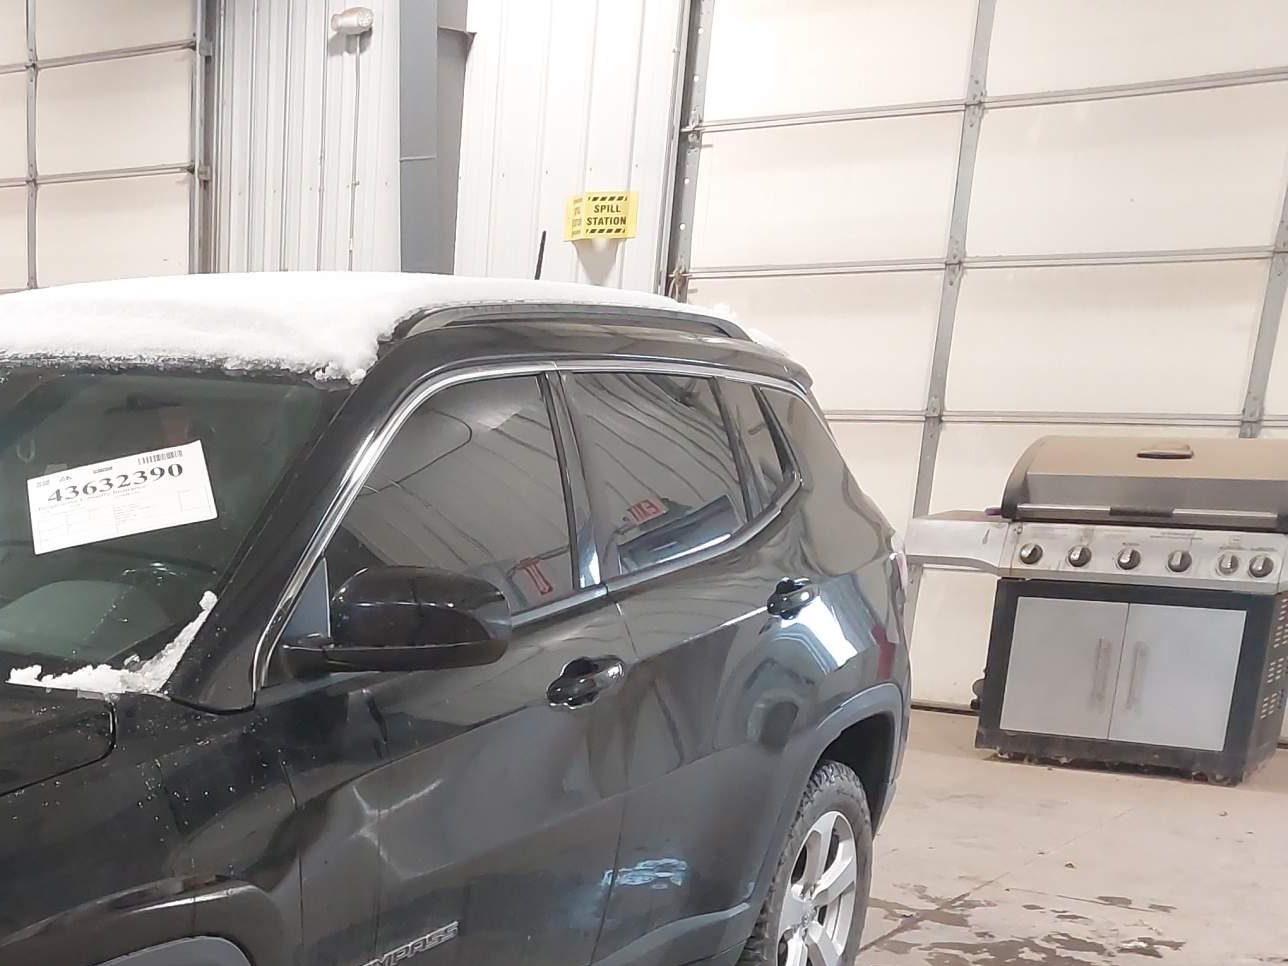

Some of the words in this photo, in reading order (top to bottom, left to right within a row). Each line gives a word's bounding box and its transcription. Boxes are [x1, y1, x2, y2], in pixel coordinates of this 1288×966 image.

[594, 204, 622, 214] SPILL
[586, 216, 627, 226] STATION
[47, 463, 184, 502] 43632390
